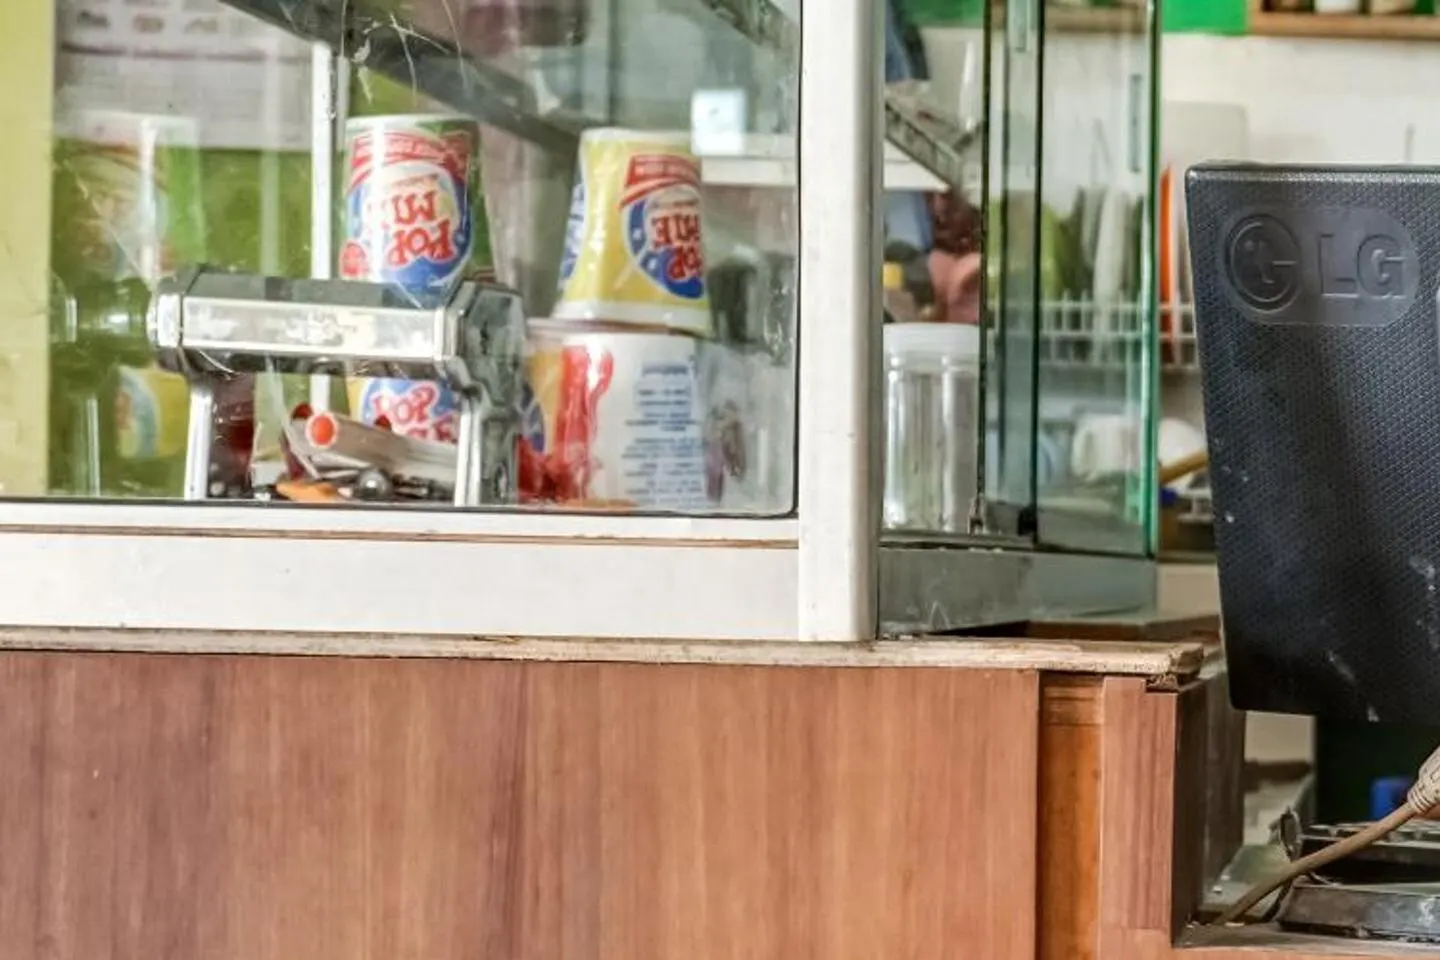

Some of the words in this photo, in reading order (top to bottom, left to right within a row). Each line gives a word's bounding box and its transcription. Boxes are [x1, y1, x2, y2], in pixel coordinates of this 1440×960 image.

[387, 217, 456, 267] POP
[667, 246, 706, 281] OP
[1316, 232, 1408, 299] LG
